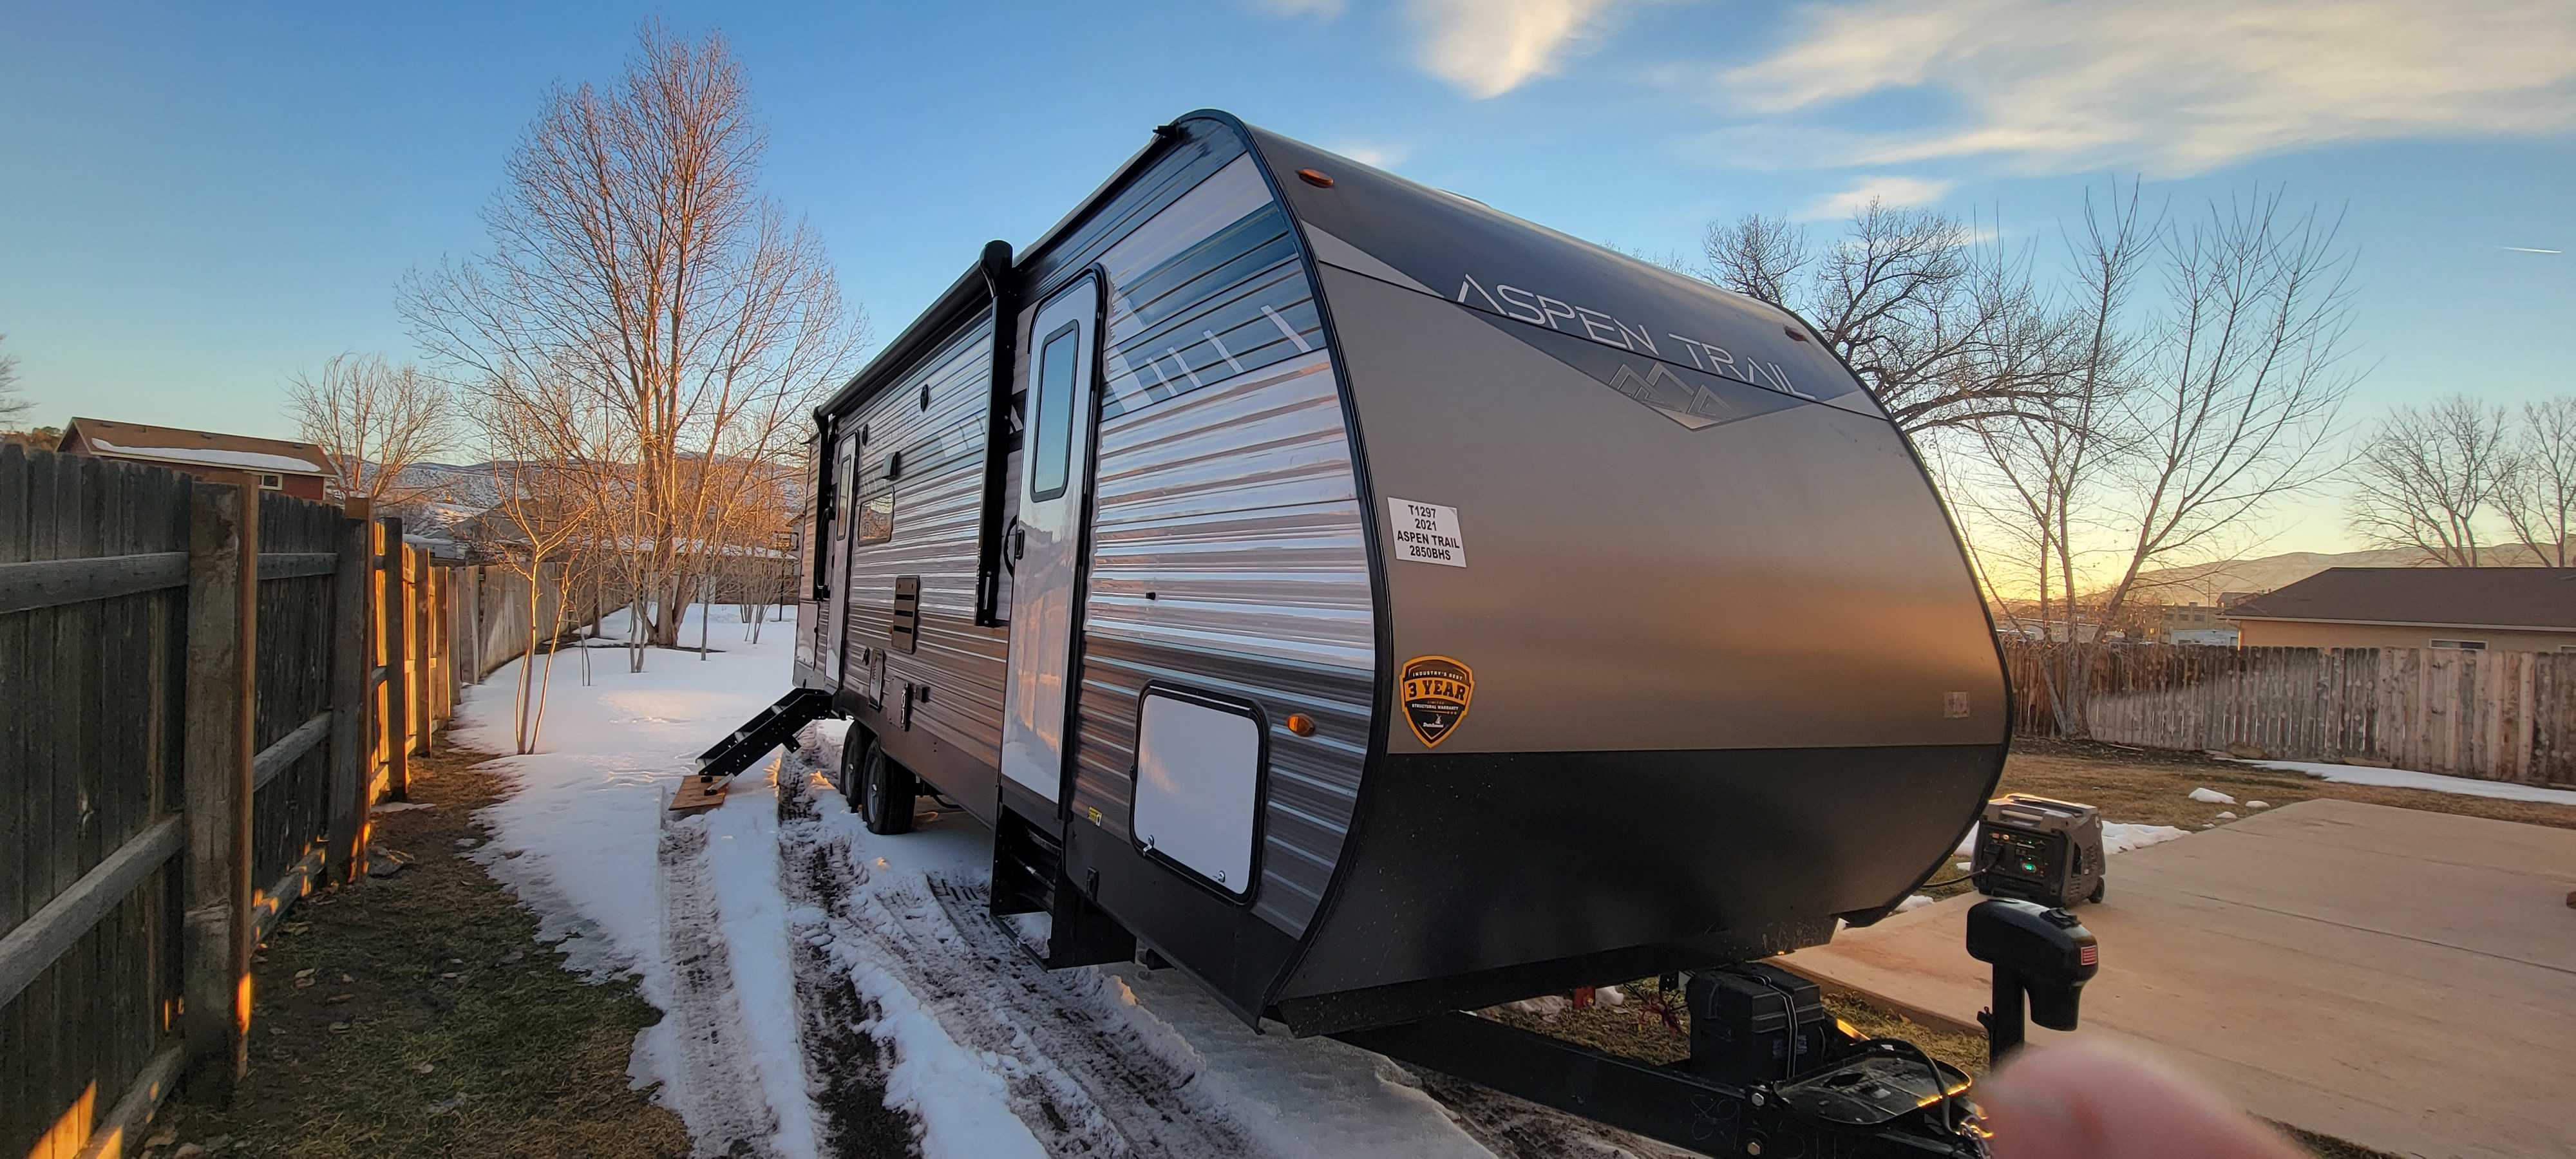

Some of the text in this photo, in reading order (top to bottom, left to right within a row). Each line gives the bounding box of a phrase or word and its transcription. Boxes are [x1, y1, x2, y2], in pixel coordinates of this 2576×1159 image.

[1457, 273, 1817, 400] ASPEN TRAIL
[1408, 504, 1436, 518] T1297
[1414, 518, 1437, 531] 2021
[1397, 530, 1460, 549] ASPEN TRAIL
[1409, 545, 1451, 561] 2850BHS
[1408, 680, 1466, 701] 3 YEAR
